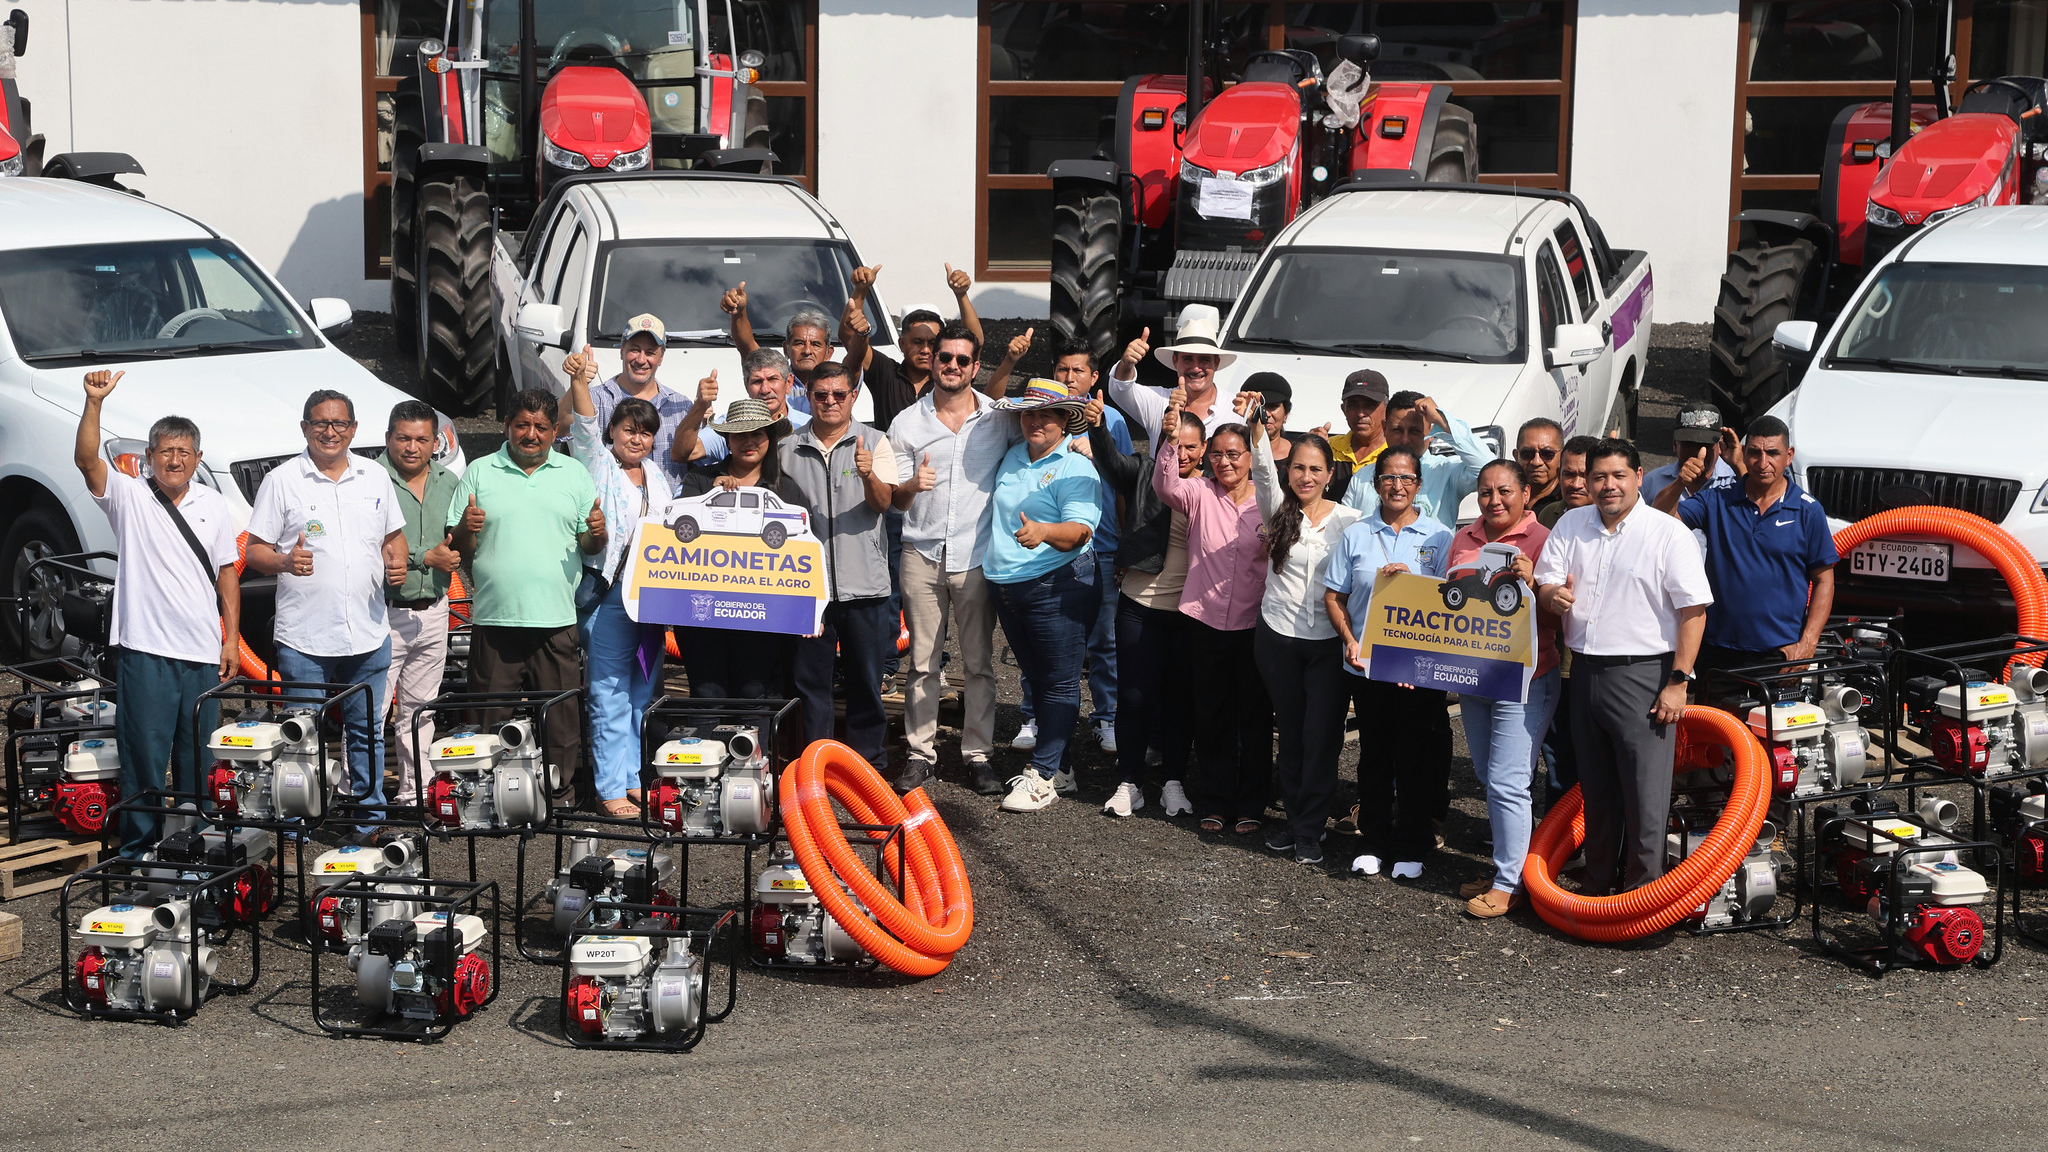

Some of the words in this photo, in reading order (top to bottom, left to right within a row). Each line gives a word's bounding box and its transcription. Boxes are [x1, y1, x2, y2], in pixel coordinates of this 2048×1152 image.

[1881, 543, 1918, 553] ECUADOR
[643, 544, 812, 574] CAMIONETAS
[1854, 551, 1945, 577] GTY-2408
[648, 569, 719, 583] MOVILIDAD
[722, 574, 756, 586] PARA
[759, 576, 773, 587] EL
[776, 578, 811, 589] AGRO
[714, 600, 752, 610] GOBIERNO
[753, 602, 767, 611] DEL
[714, 609, 766, 620] ECUADOR
[1383, 605, 1512, 640] TRACTORES
[1383, 628, 1441, 644] TECNOLOGÍA
[1443, 636, 1469, 648] PARA
[1471, 640, 1483, 650] EL
[1483, 642, 1511, 654] AGRO
[1434, 663, 1467, 675] GOBIERNO
[1467, 667, 1479, 676] DEL
[1433, 671, 1479, 686] ECUADOR
[586, 950, 616, 958] WP20T
